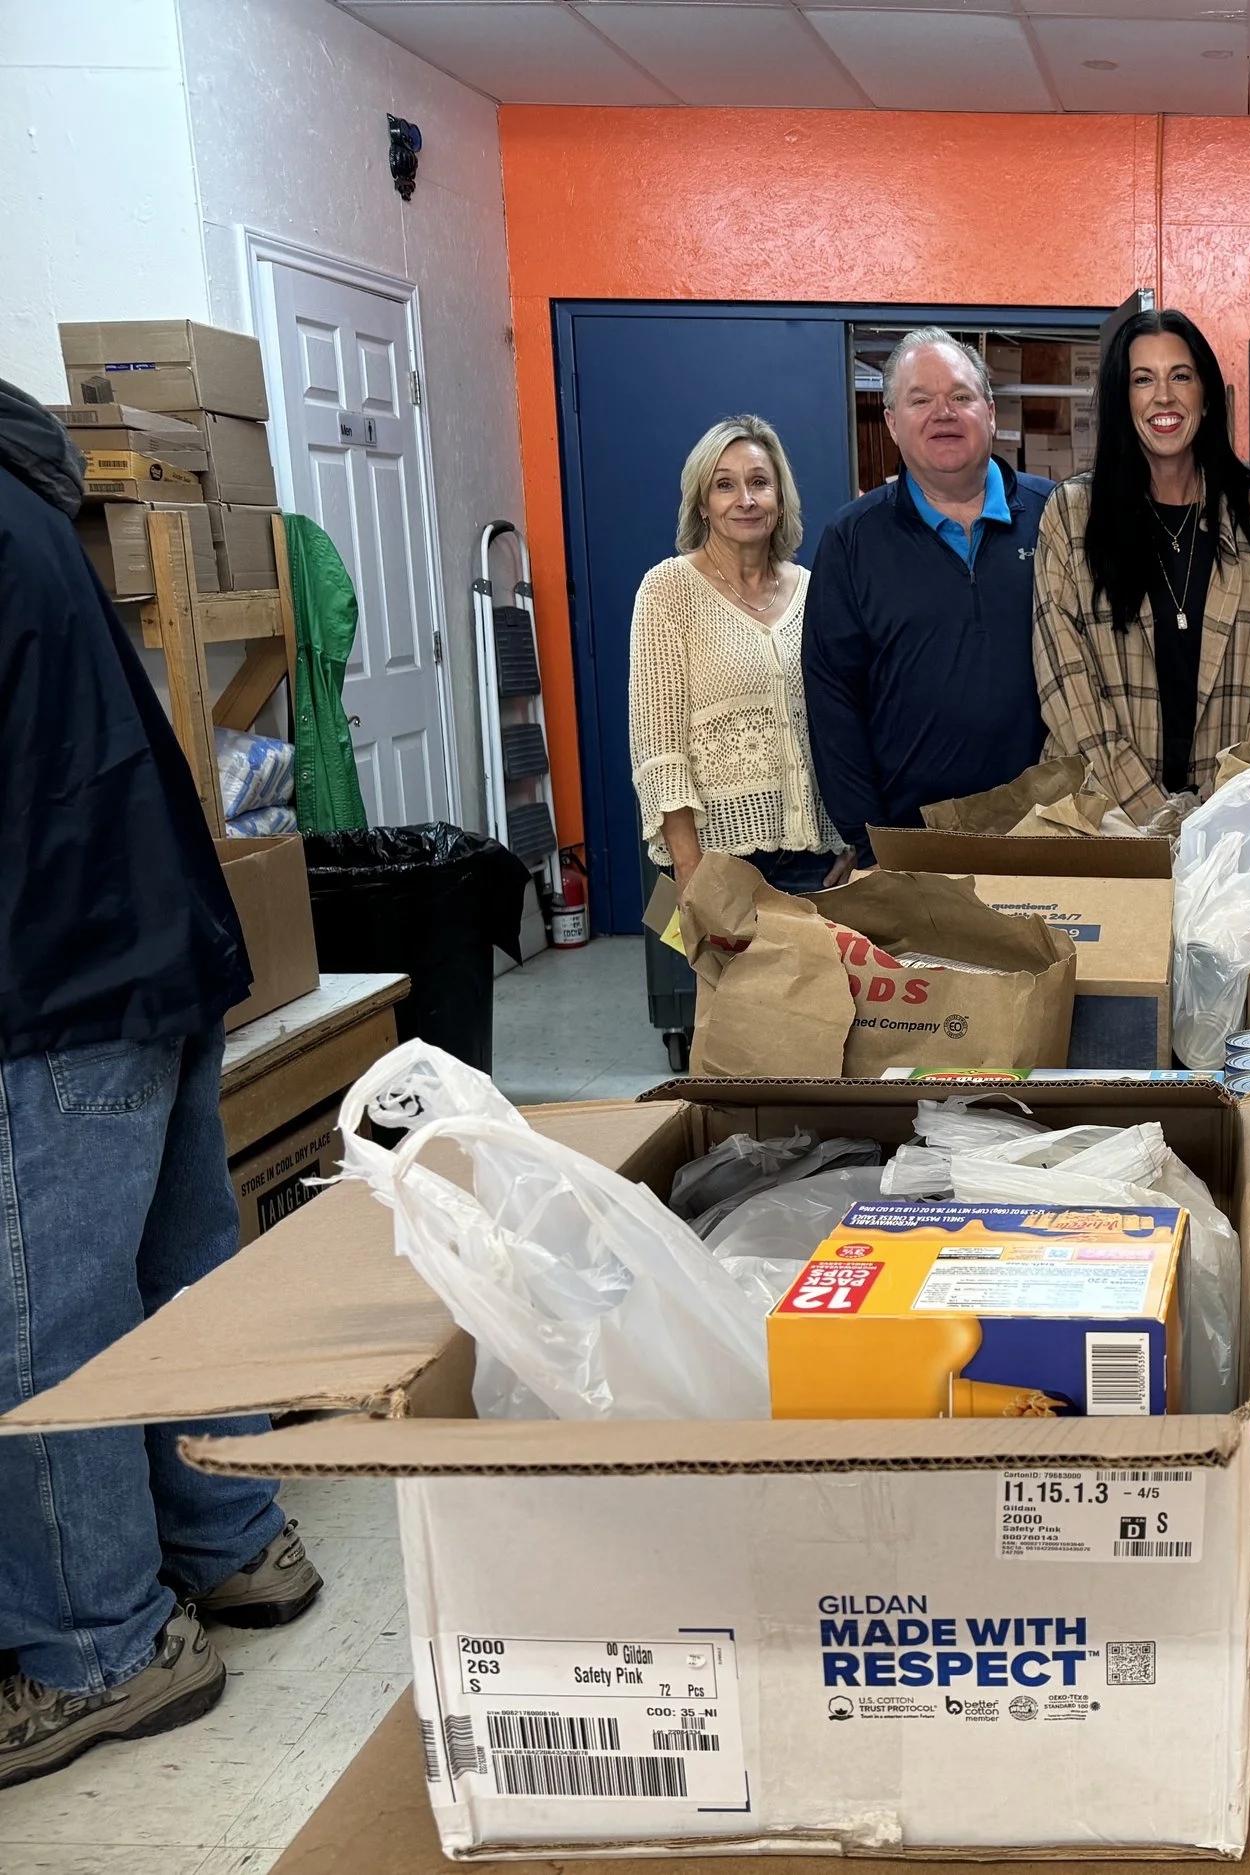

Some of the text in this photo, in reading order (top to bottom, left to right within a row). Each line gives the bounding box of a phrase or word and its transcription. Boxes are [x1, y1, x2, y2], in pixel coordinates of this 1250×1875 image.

[340, 424, 353, 437] Men
[992, 903, 1059, 911] questions?
[1049, 913, 1082, 921] 24/7
[880, 1018, 940, 1033] Company
[240, 1132, 331, 1197] STORE IN COOL DRY PLACE
[811, 1269, 870, 1278] CUPS
[803, 1277, 866, 1287] PACK
[792, 1286, 852, 1309] 12
[1137, 1487, 1160, 1499] 4/5
[1003, 1504, 1036, 1512] Gildan
[1003, 1513, 1043, 1525] 2000
[1156, 1511, 1168, 1534] S
[1003, 1525, 1061, 1533] Safety Pink
[1127, 1524, 1140, 1538] D
[819, 1595, 927, 1615] GILDAN
[820, 1617, 1087, 1647] MADE WITH
[461, 1637, 654, 1665] 2000 00 Gildan
[467, 1659, 644, 1687] 263 Safety Pink
[469, 1678, 705, 1697] S 72 Pcs
[877, 1696, 914, 1704] COTTON
[964, 1700, 999, 1708] better
[646, 1707, 676, 1717] COO:
[680, 1708, 695, 1717] 35
[964, 1707, 999, 1715] cotton
